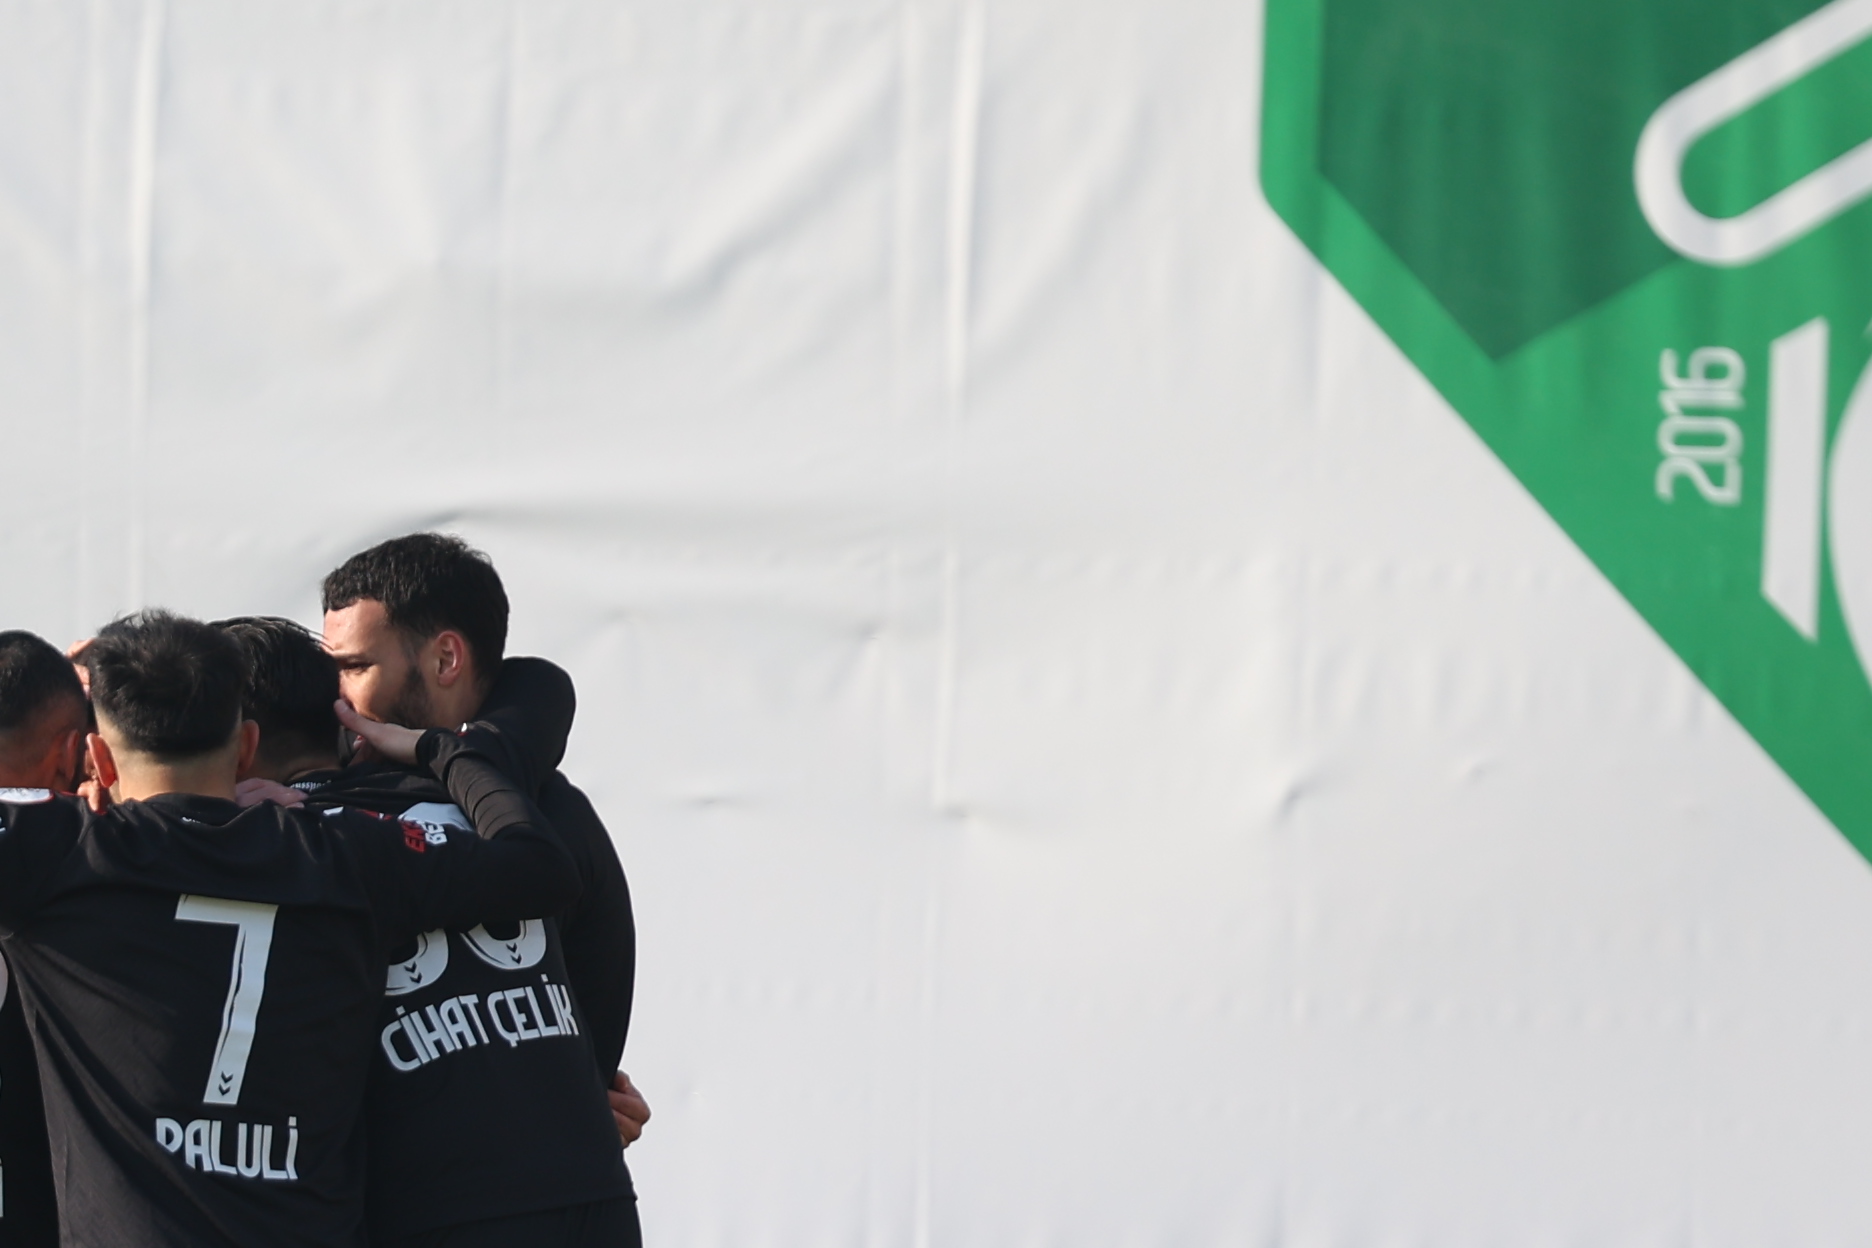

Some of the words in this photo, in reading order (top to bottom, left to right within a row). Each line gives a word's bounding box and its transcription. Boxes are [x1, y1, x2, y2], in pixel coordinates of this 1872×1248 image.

[1655, 346, 1747, 505] 2016
[175, 893, 279, 1105] 7
[381, 993, 491, 1072] CİHAT
[486, 973, 579, 1047] ÇELİK
[156, 1116, 299, 1180] PALULİ
